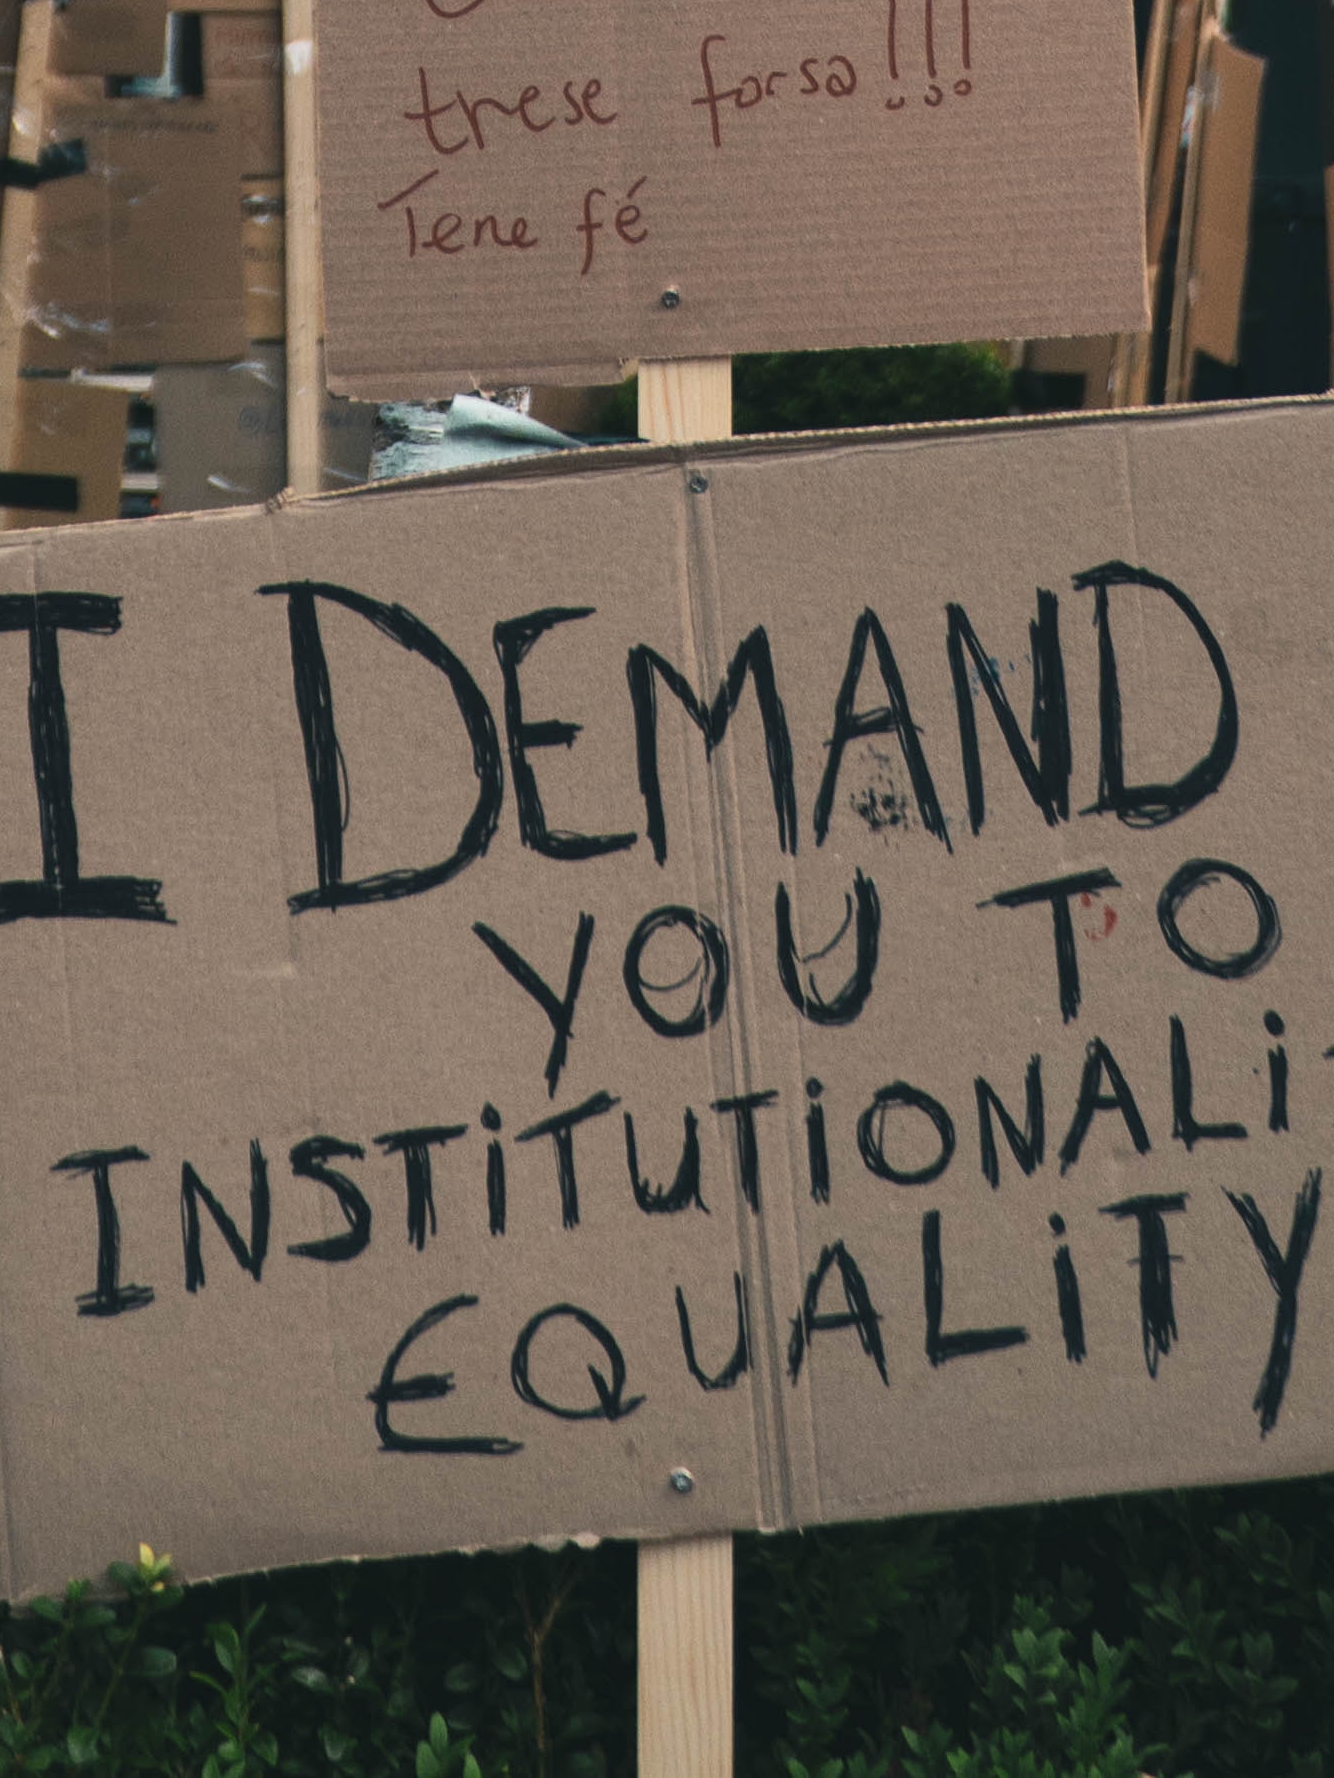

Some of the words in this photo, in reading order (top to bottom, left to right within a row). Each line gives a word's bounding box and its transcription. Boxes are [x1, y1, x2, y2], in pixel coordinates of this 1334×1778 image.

[403, 65, 620, 155] trese
[376, 167, 539, 257] Tene
[576, 175, 648, 275] fé
[255, 557, 1240, 917] DEMAND
[471, 866, 884, 1096] YOU
[973, 854, 1284, 1026] TO
